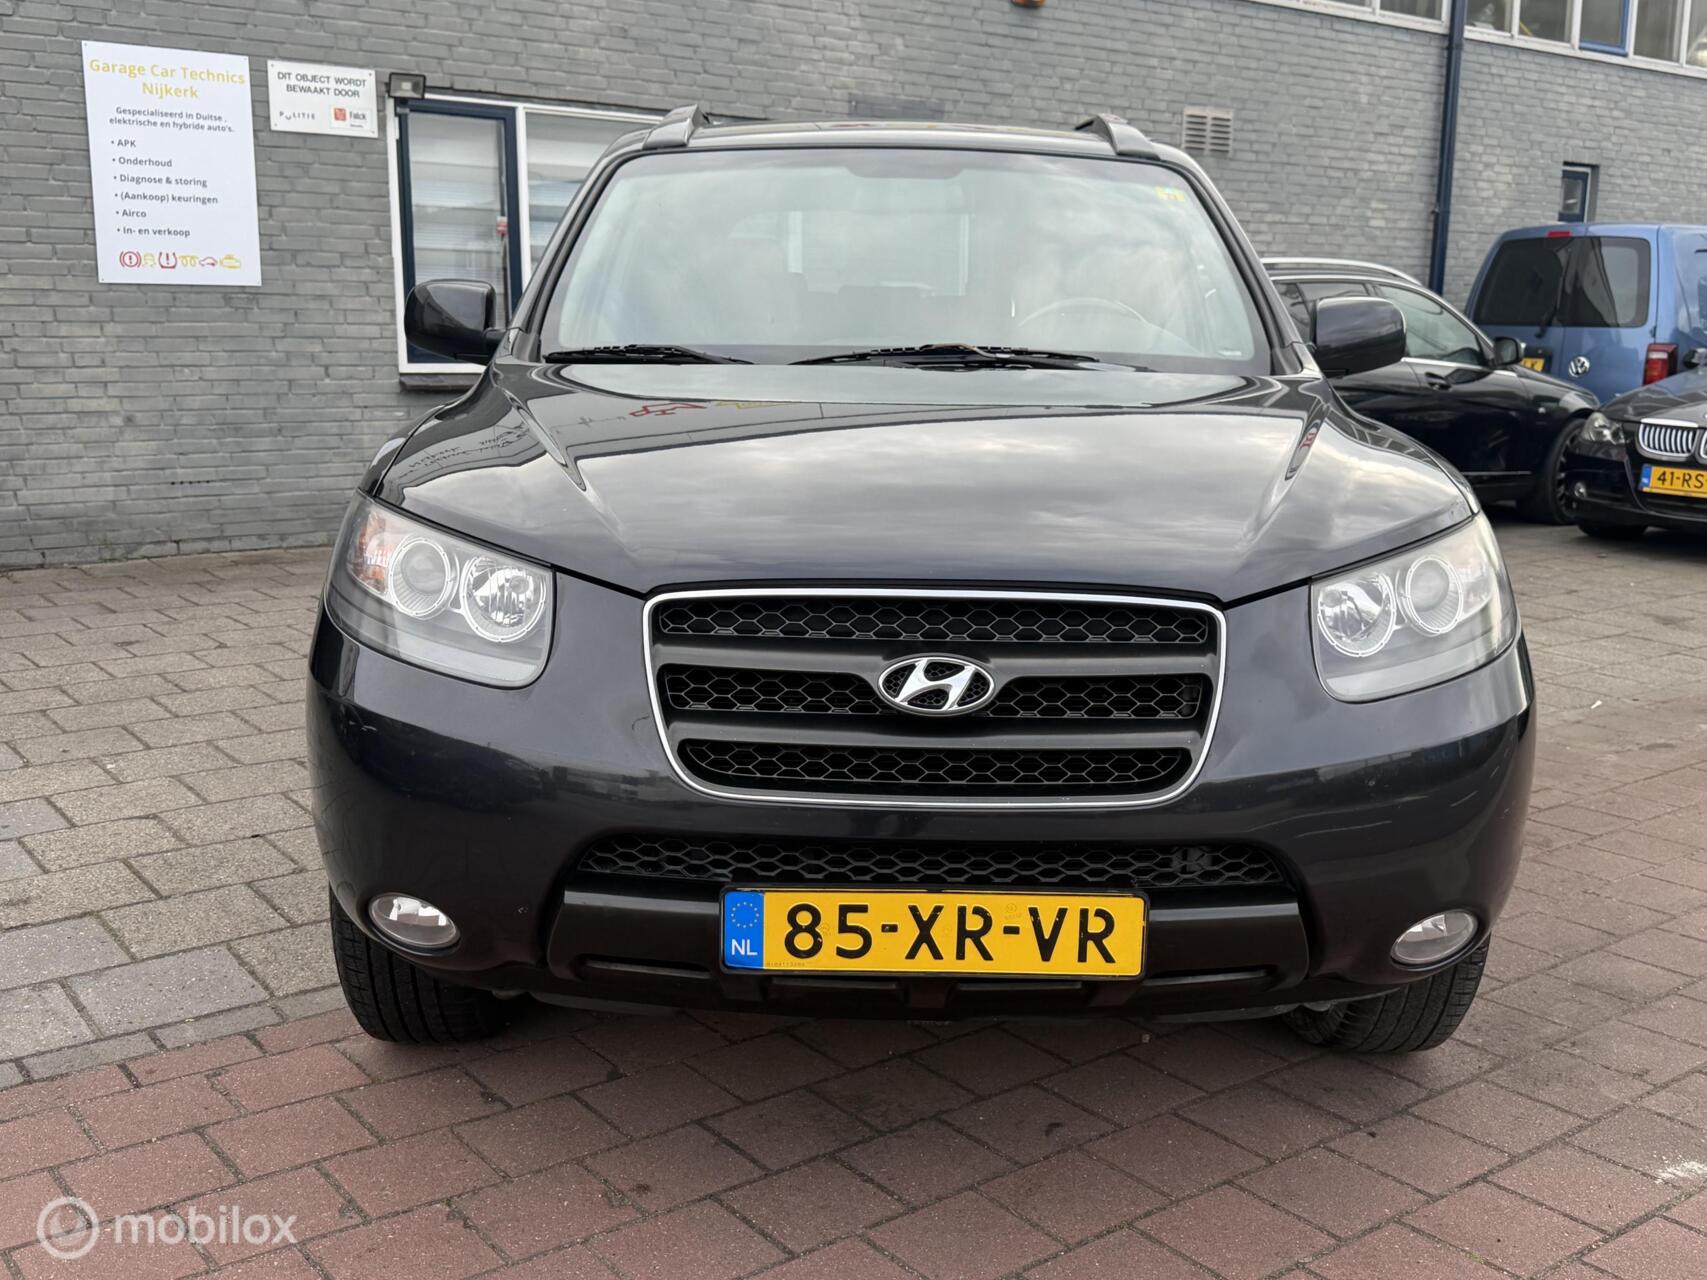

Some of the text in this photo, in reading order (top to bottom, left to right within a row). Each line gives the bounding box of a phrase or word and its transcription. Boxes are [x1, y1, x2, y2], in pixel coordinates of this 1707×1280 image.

[90, 58, 246, 84] Garage Car Technics
[277, 71, 367, 87] DIT OBJECT WORDT
[142, 82, 199, 99] Nijkerk
[286, 84, 360, 98] BEWAAKT DOOR
[116, 106, 183, 119] Gespecialiseerd
[185, 112, 194, 120] in
[109, 117, 158, 128] elektrische
[173, 121, 205, 132] hybride
[117, 139, 136, 148] APK
[118, 156, 173, 167] Onderhoud
[119, 174, 208, 188] Diagnose & storing
[120, 191, 219, 205] (Aankoop) keuringen
[122, 209, 147, 218] Airco
[123, 226, 191, 238] In- en verkoop
[784, 903, 1116, 964] 85-XR-VR
[731, 938, 758, 957] NL
